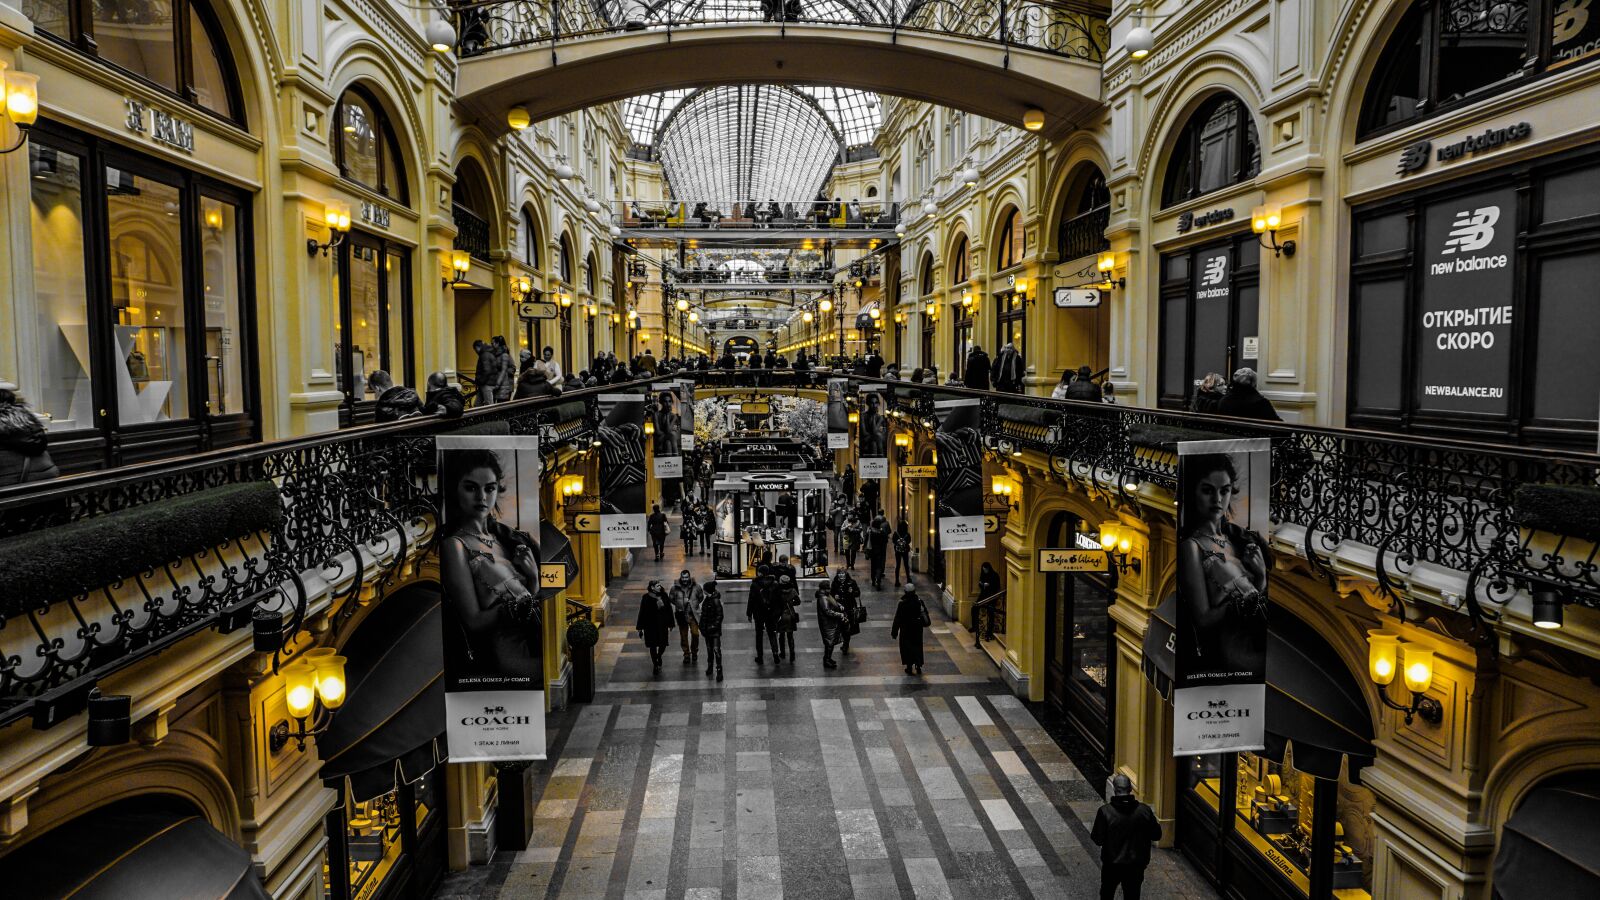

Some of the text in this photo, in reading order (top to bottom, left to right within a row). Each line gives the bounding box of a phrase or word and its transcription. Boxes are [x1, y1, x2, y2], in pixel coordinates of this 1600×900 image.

[1436, 121, 1532, 162] new balance
[1431, 254, 1507, 275] new balance
[1196, 286, 1230, 299] new balance
[1423, 306, 1512, 328] ОТКРЫТИЕ
[1436, 331, 1494, 350] СКОРО
[1425, 385, 1503, 398] NEWBALANCE.RU
[540, 571, 558, 583] iegi
[461, 716, 530, 726] COACH
[1187, 709, 1249, 720] COACH
[1265, 848, 1293, 877] Sublime
[357, 876, 379, 900] ublime
